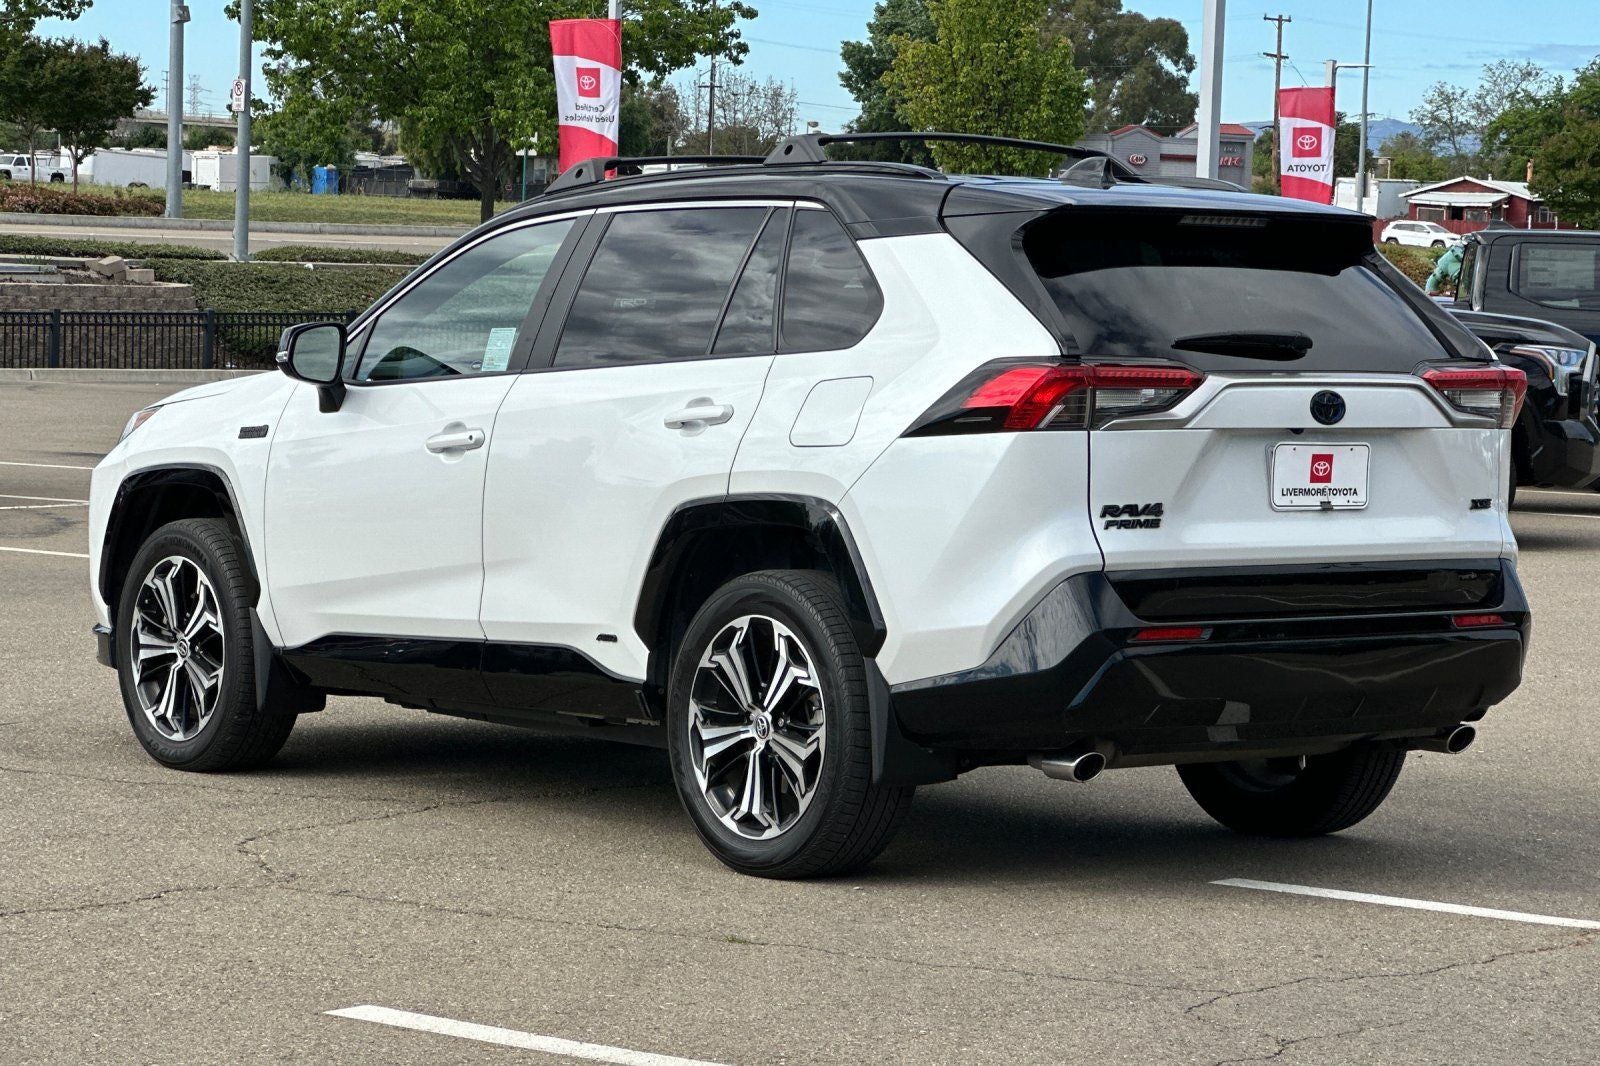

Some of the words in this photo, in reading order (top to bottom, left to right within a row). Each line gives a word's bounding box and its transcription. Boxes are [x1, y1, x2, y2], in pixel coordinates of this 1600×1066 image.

[1281, 488, 1326, 497] LIVERMORE
[1328, 488, 1358, 496] TOYOTA
[1100, 502, 1163, 518] RAV4
[1104, 519, 1161, 530] PRIME
